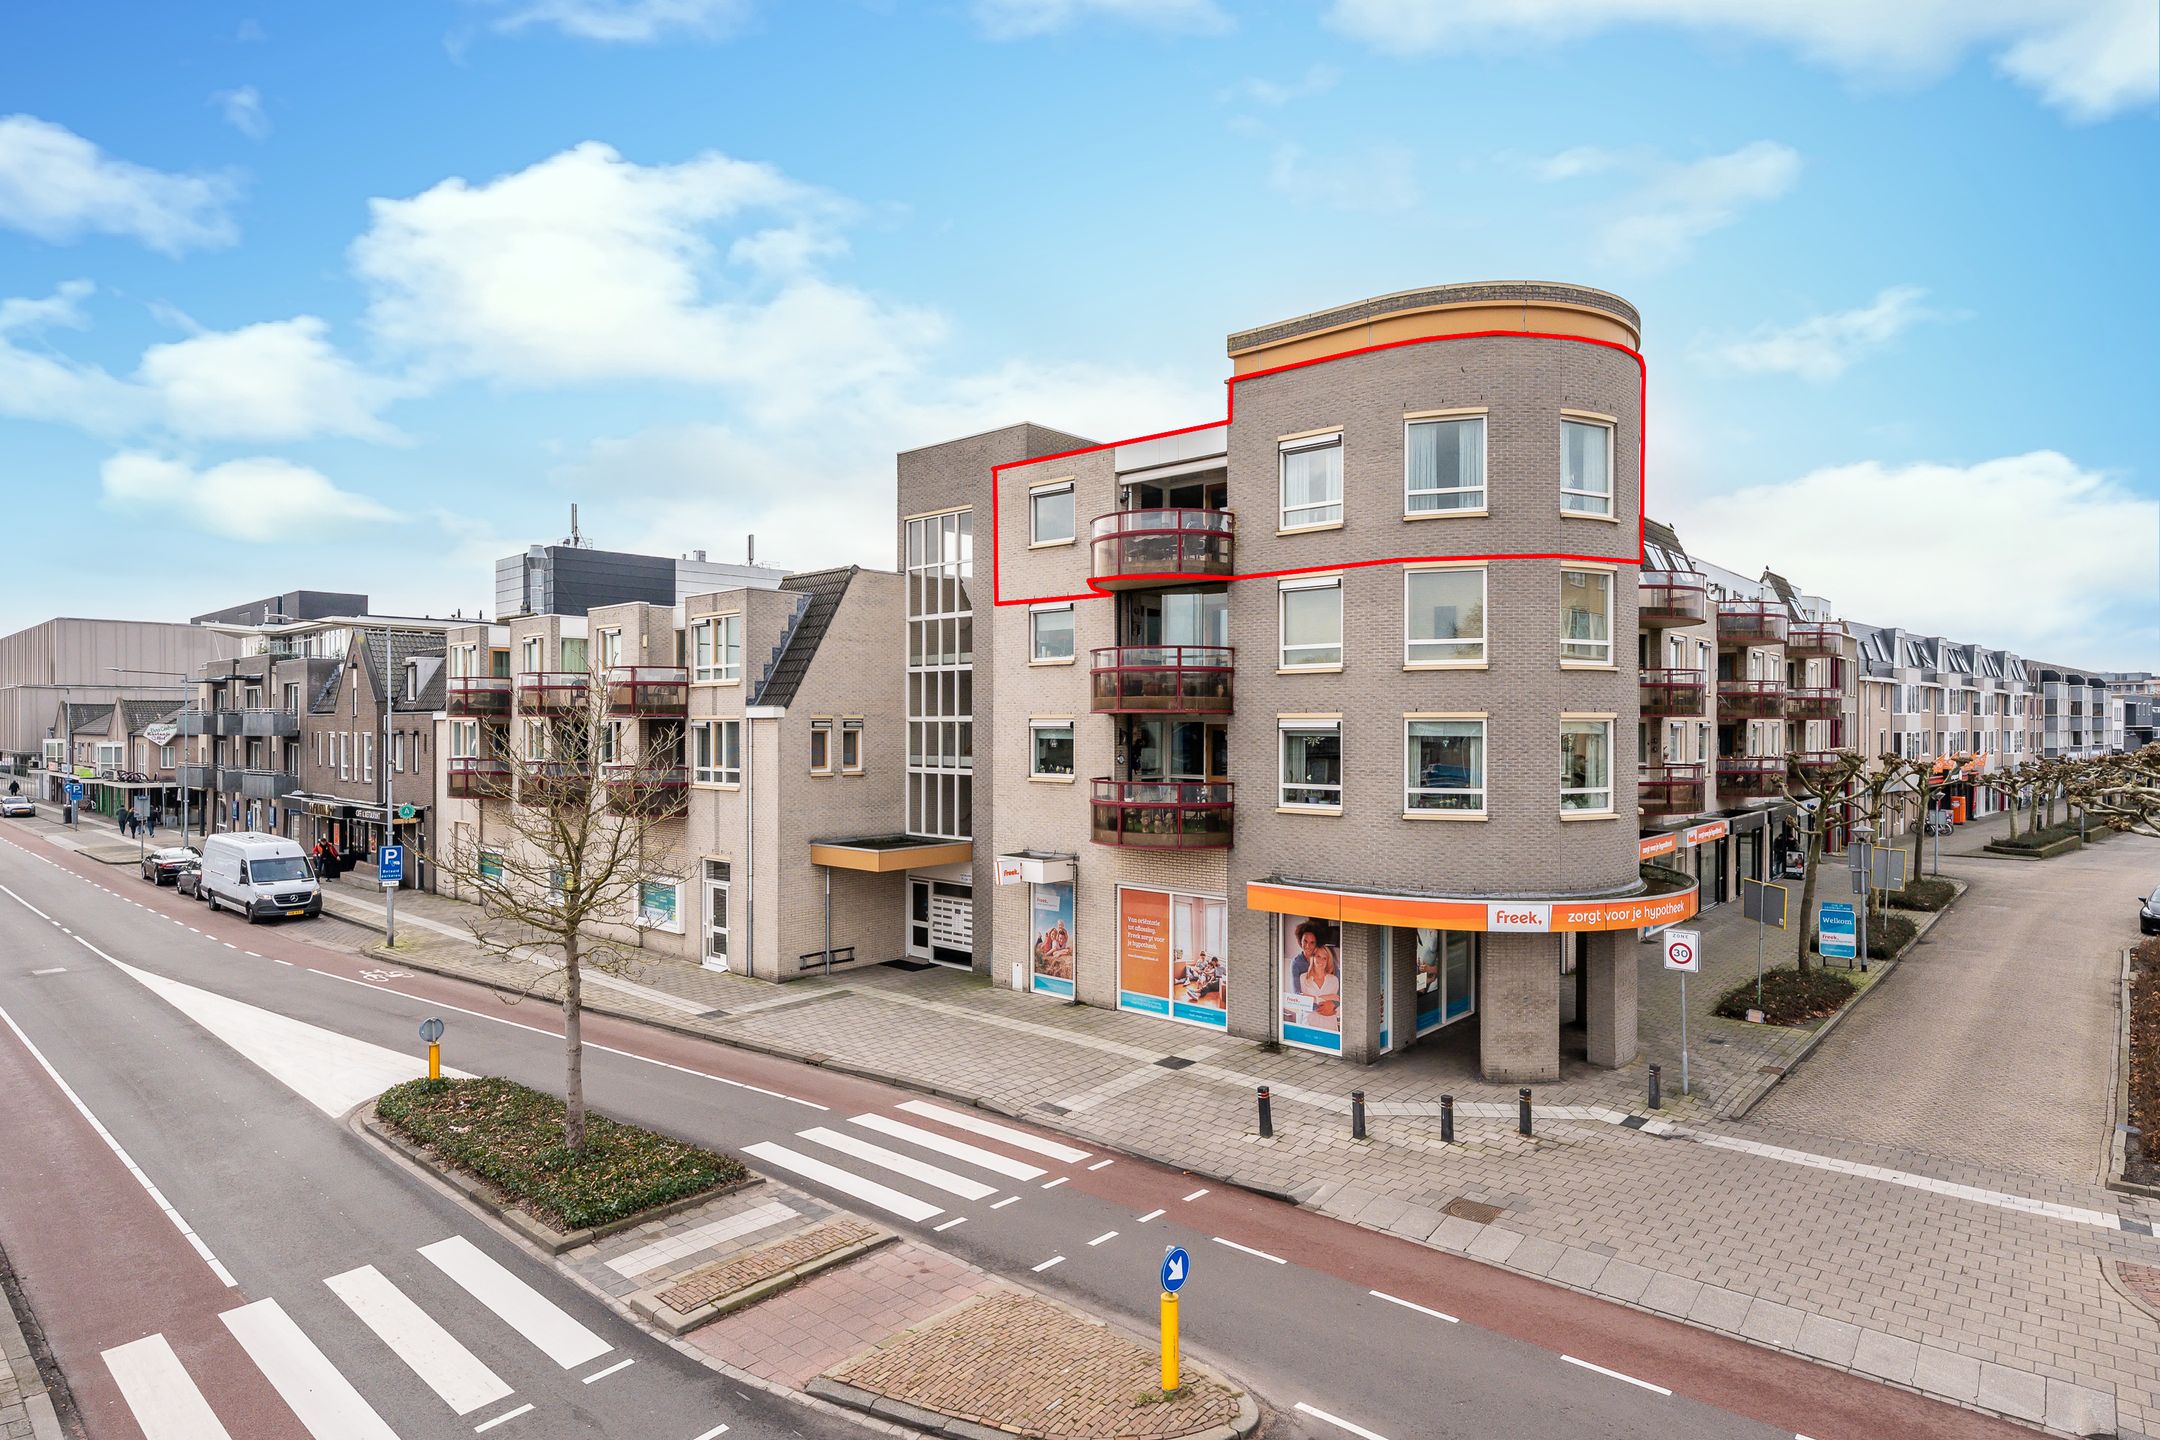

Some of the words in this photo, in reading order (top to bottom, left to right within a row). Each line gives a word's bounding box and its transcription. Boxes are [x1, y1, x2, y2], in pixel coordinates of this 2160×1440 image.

[385, 849, 398, 865] P
[1567, 909, 1602, 925] zorgt
[1603, 910, 1631, 921] voor
[1631, 906, 1642, 922] je
[1644, 900, 1685, 919] hypotheek
[1822, 917, 1853, 925] Welkom
[1673, 948, 1689, 958] 30
